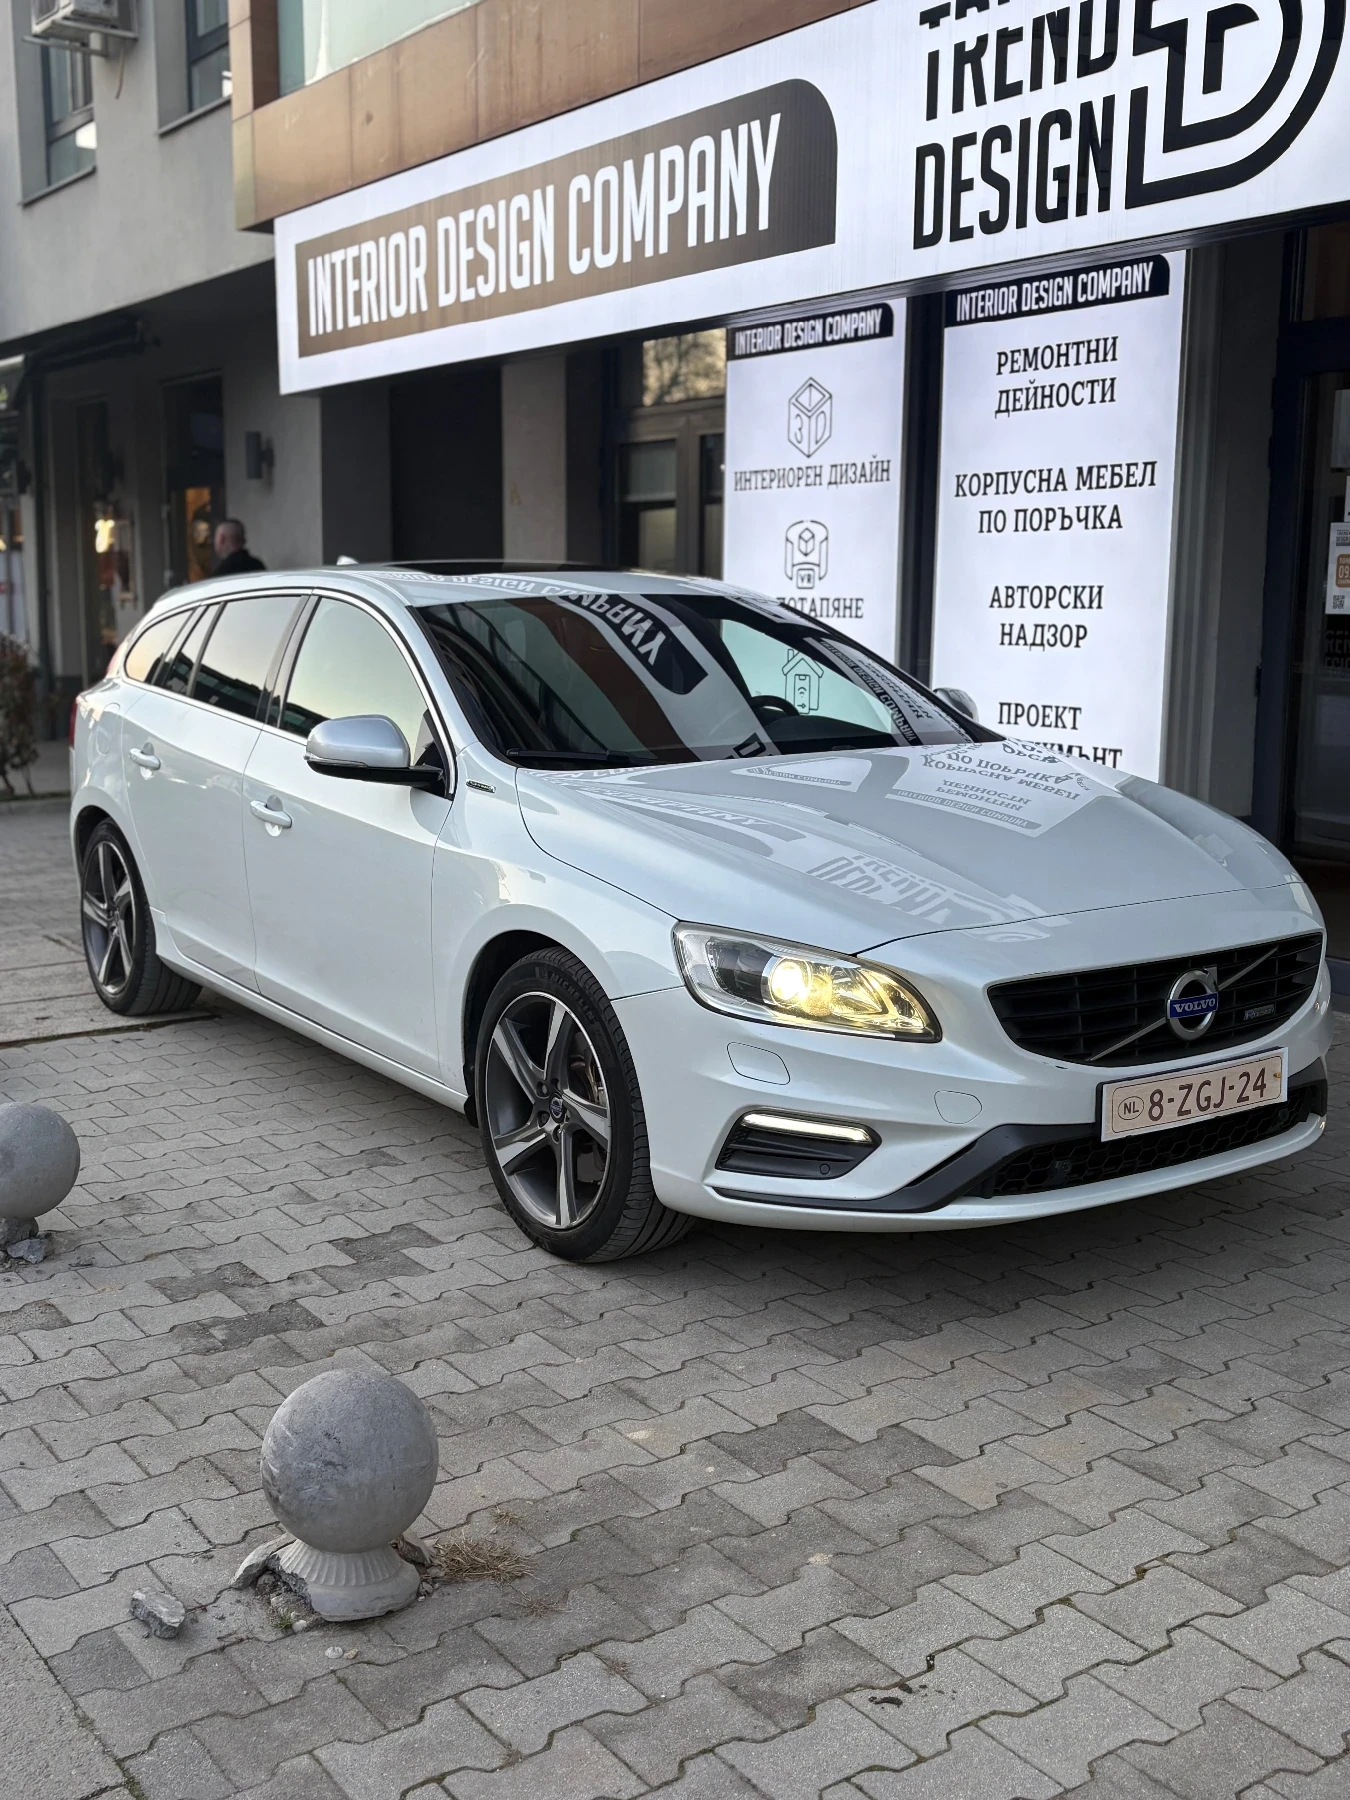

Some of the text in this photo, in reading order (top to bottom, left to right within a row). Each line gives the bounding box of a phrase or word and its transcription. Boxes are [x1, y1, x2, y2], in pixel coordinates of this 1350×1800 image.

[919, 0, 1121, 121] TREND
[913, 94, 1115, 250] DESIGN
[307, 112, 781, 336] INTERIOR DESIGN COMPANY
[955, 261, 1154, 322] INTERIOR DESIGN COMPANY
[734, 308, 883, 356] INTERIOR DESIGN COMPANY
[996, 336, 1119, 376] РЕМОНТНИ
[994, 377, 1117, 420] ДЕЙНОСТИ
[733, 453, 892, 492] ИНТЕРИОРЕН ДИЗАЙН
[954, 461, 1158, 498] КОРПУСНА МЕБЕЛ
[978, 504, 1123, 534] ПО ПОРЪЧКА
[989, 585, 1104, 610] АВТОРСКИ
[999, 623, 1088, 651] НАДЗОР
[998, 702, 1082, 731] ПРОЕКТ
[1172, 997, 1216, 1013] VOLVO
[1123, 1067, 1267, 1122] NL 8-ZGJ-24
